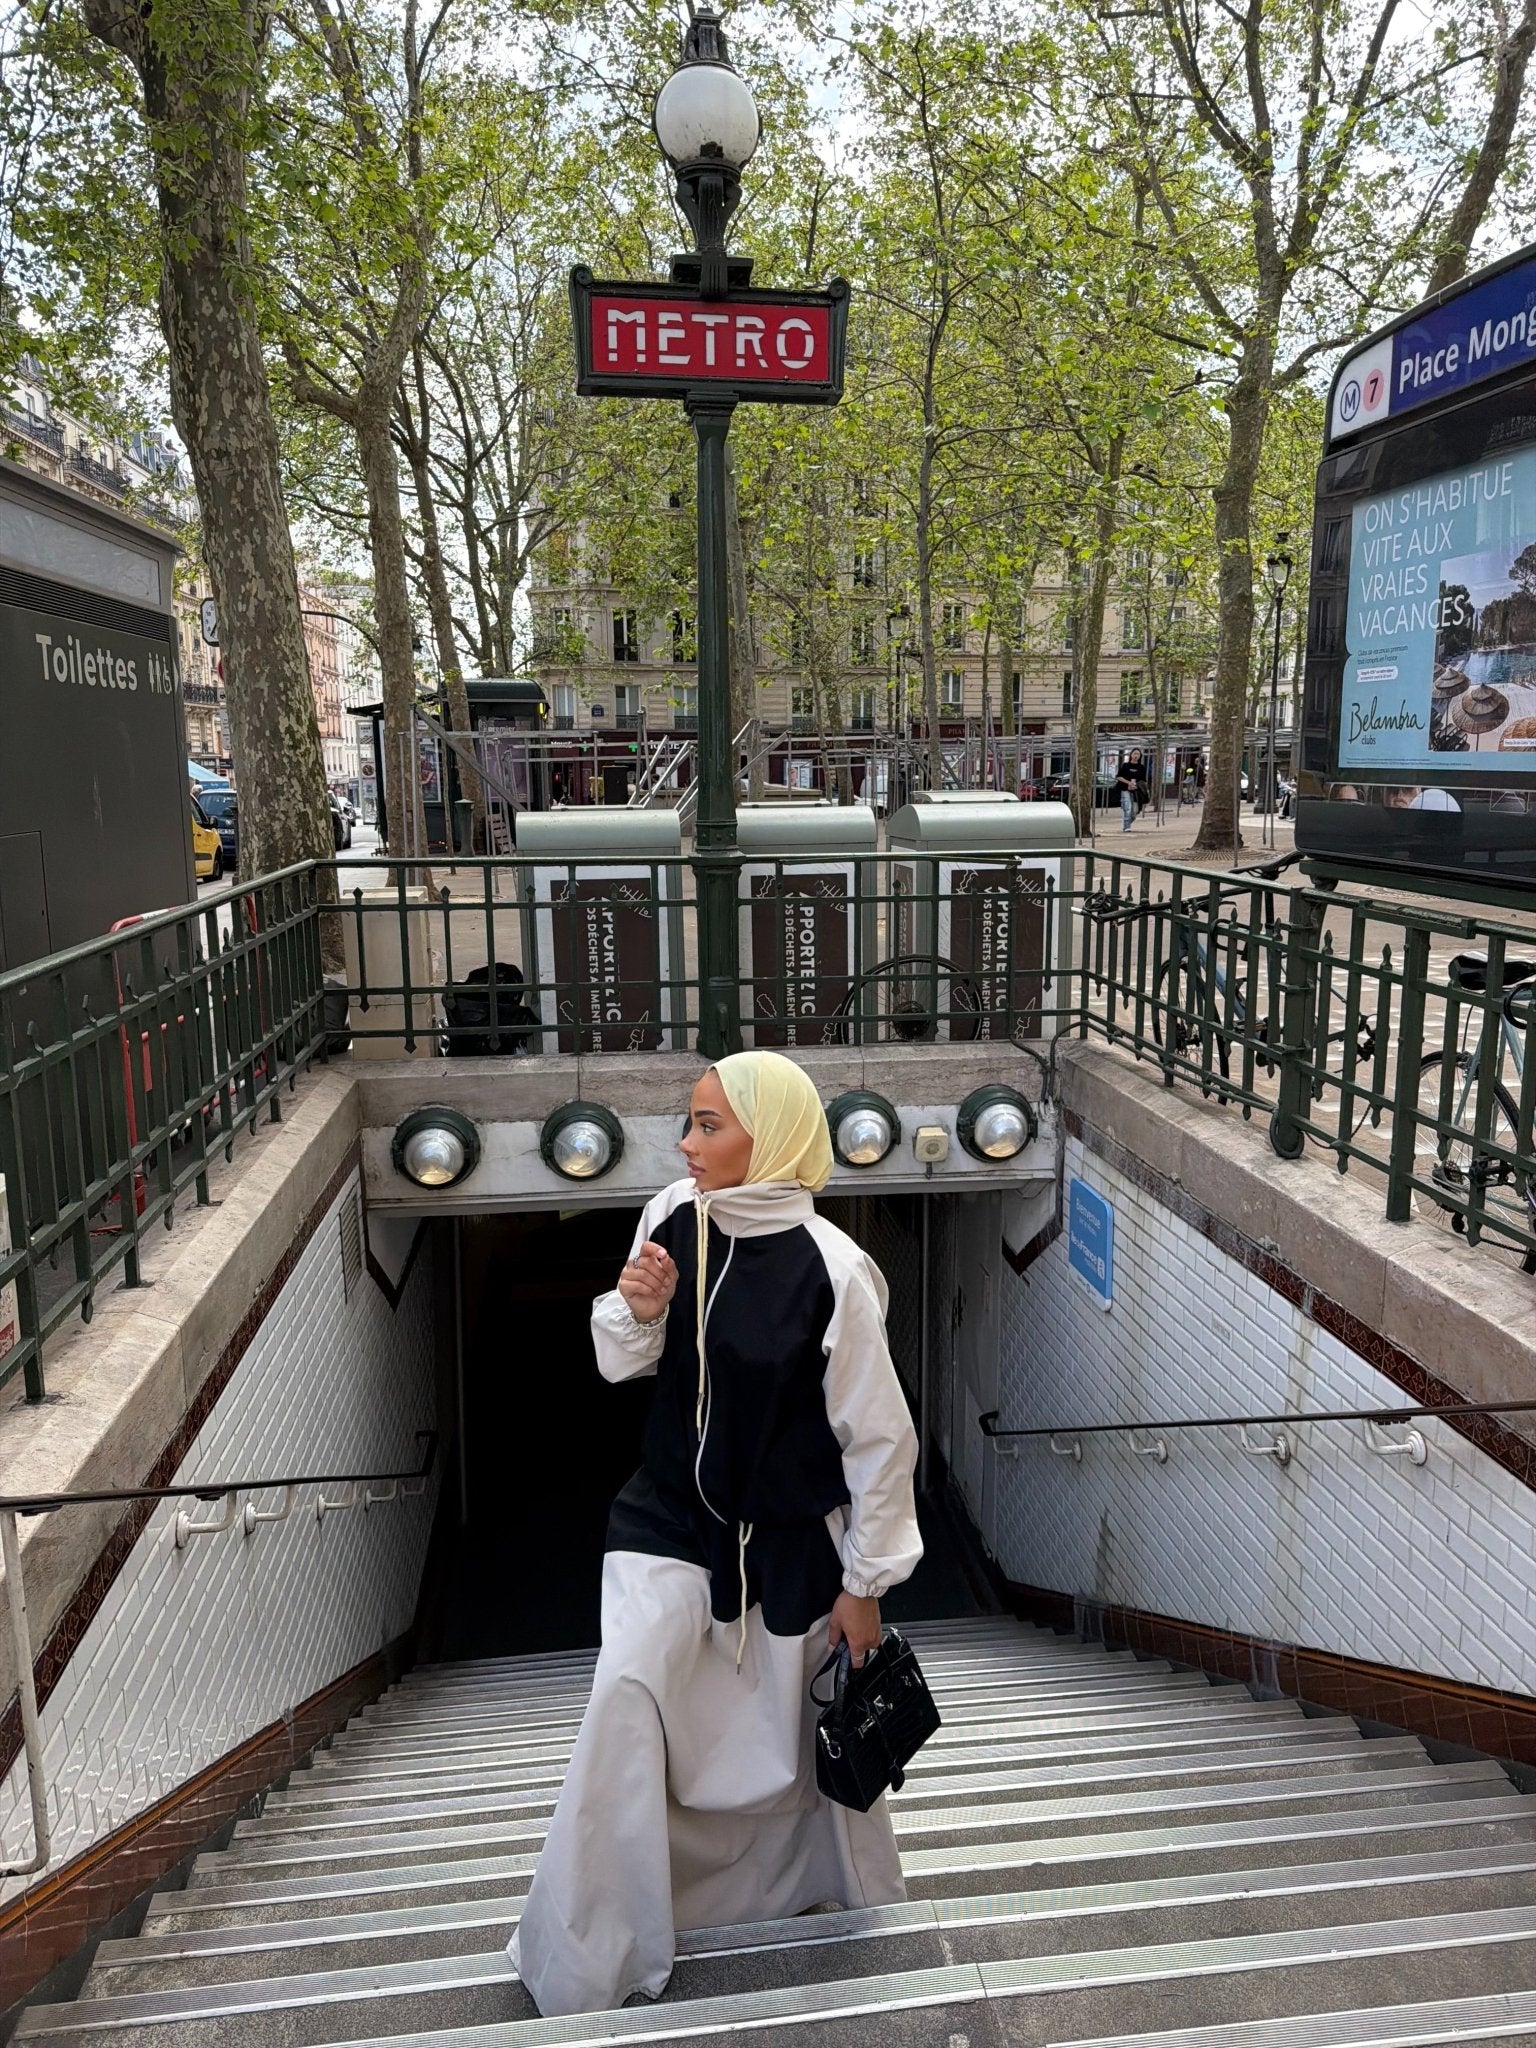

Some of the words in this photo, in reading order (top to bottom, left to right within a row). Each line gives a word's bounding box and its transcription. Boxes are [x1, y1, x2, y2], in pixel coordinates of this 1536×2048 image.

[607, 309, 815, 369] METRO
[1369, 377, 1379, 404] 7
[1399, 342, 1459, 394] Place
[1364, 498, 1395, 534] ON
[1398, 462, 1514, 526] S'HABITUE
[1362, 534, 1402, 569] VITE
[1407, 519, 1453, 556] AUX
[1361, 563, 1428, 604] VRAIES
[1359, 594, 1466, 639] VACANCES
[36, 633, 138, 692] Toilettes
[1348, 696, 1425, 744] Belambra
[1361, 735, 1376, 745] clubs
[587, 923, 600, 974] DÉCHETS
[784, 918, 797, 968] DÉCHETS
[982, 912, 994, 961] DÉCHETS
